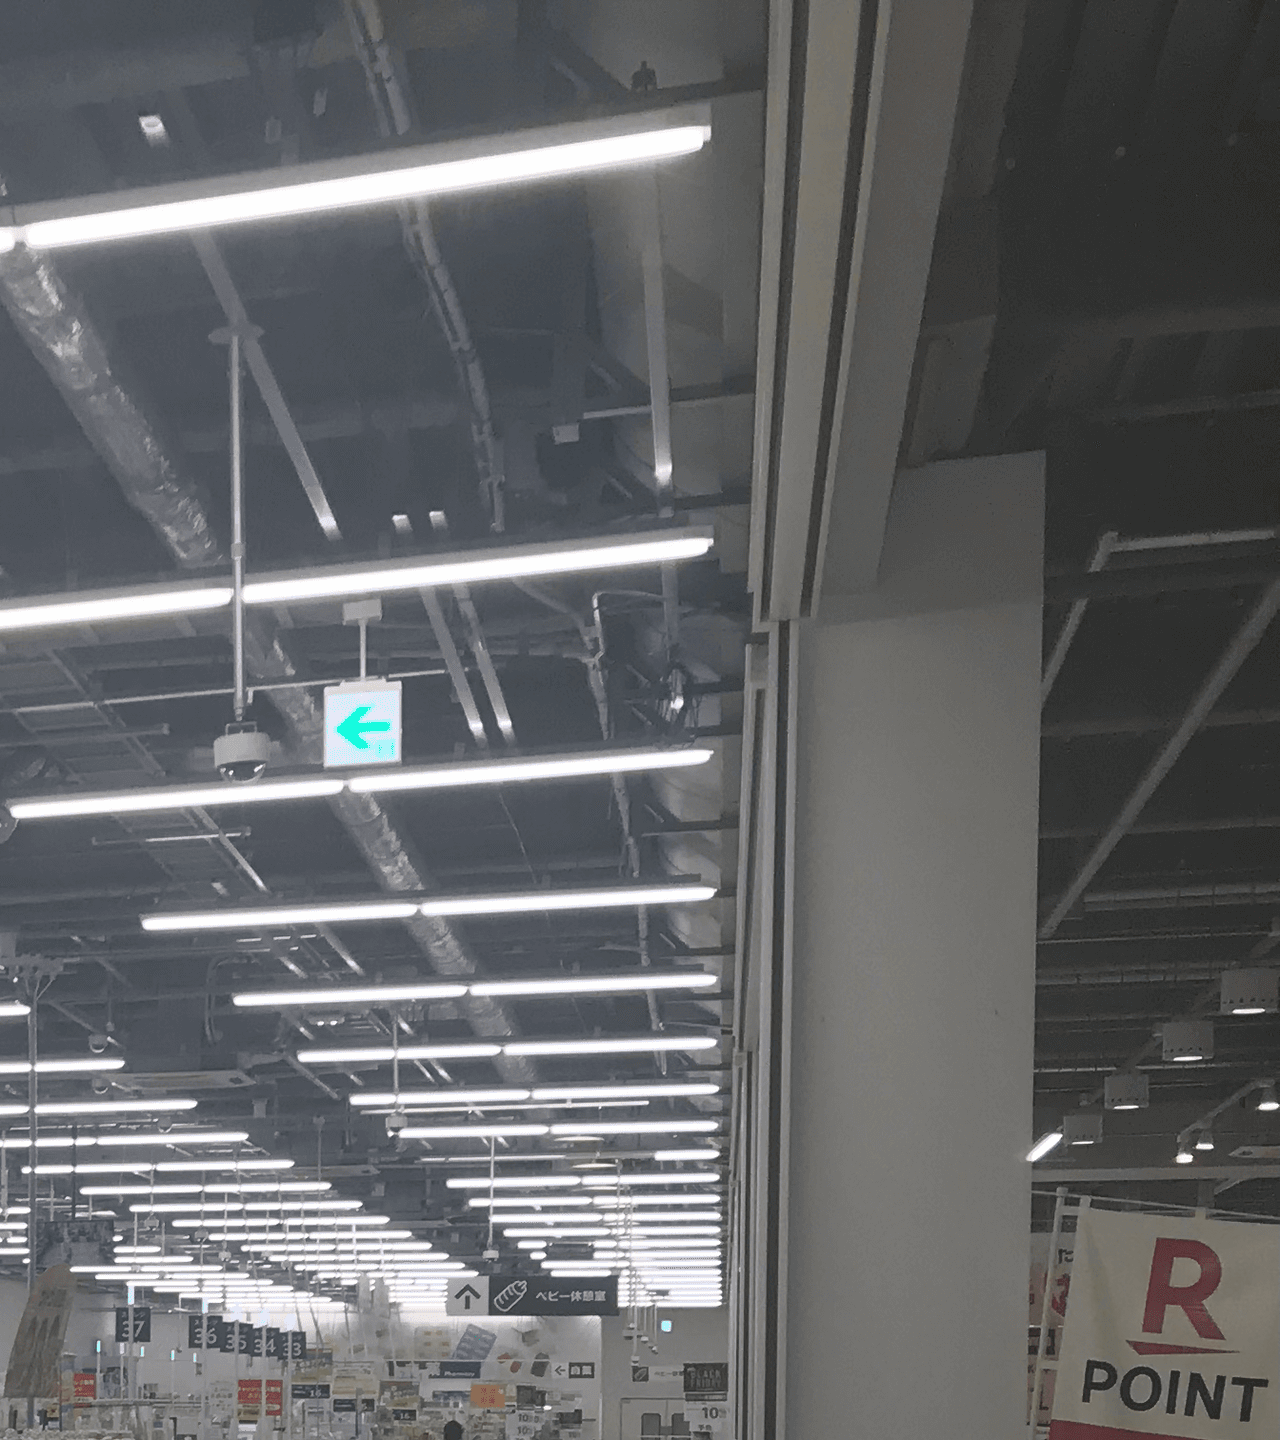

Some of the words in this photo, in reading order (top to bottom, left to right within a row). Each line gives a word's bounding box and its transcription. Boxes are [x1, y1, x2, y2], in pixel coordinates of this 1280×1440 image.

[535, 1289, 607, 1303] ベビー休憩室
[1141, 1236, 1227, 1341] R
[121, 1320, 146, 1339] 37
[193, 1328, 217, 1345] 36
[253, 1338, 277, 1354] 34
[1081, 1359, 1269, 1422] POINT
